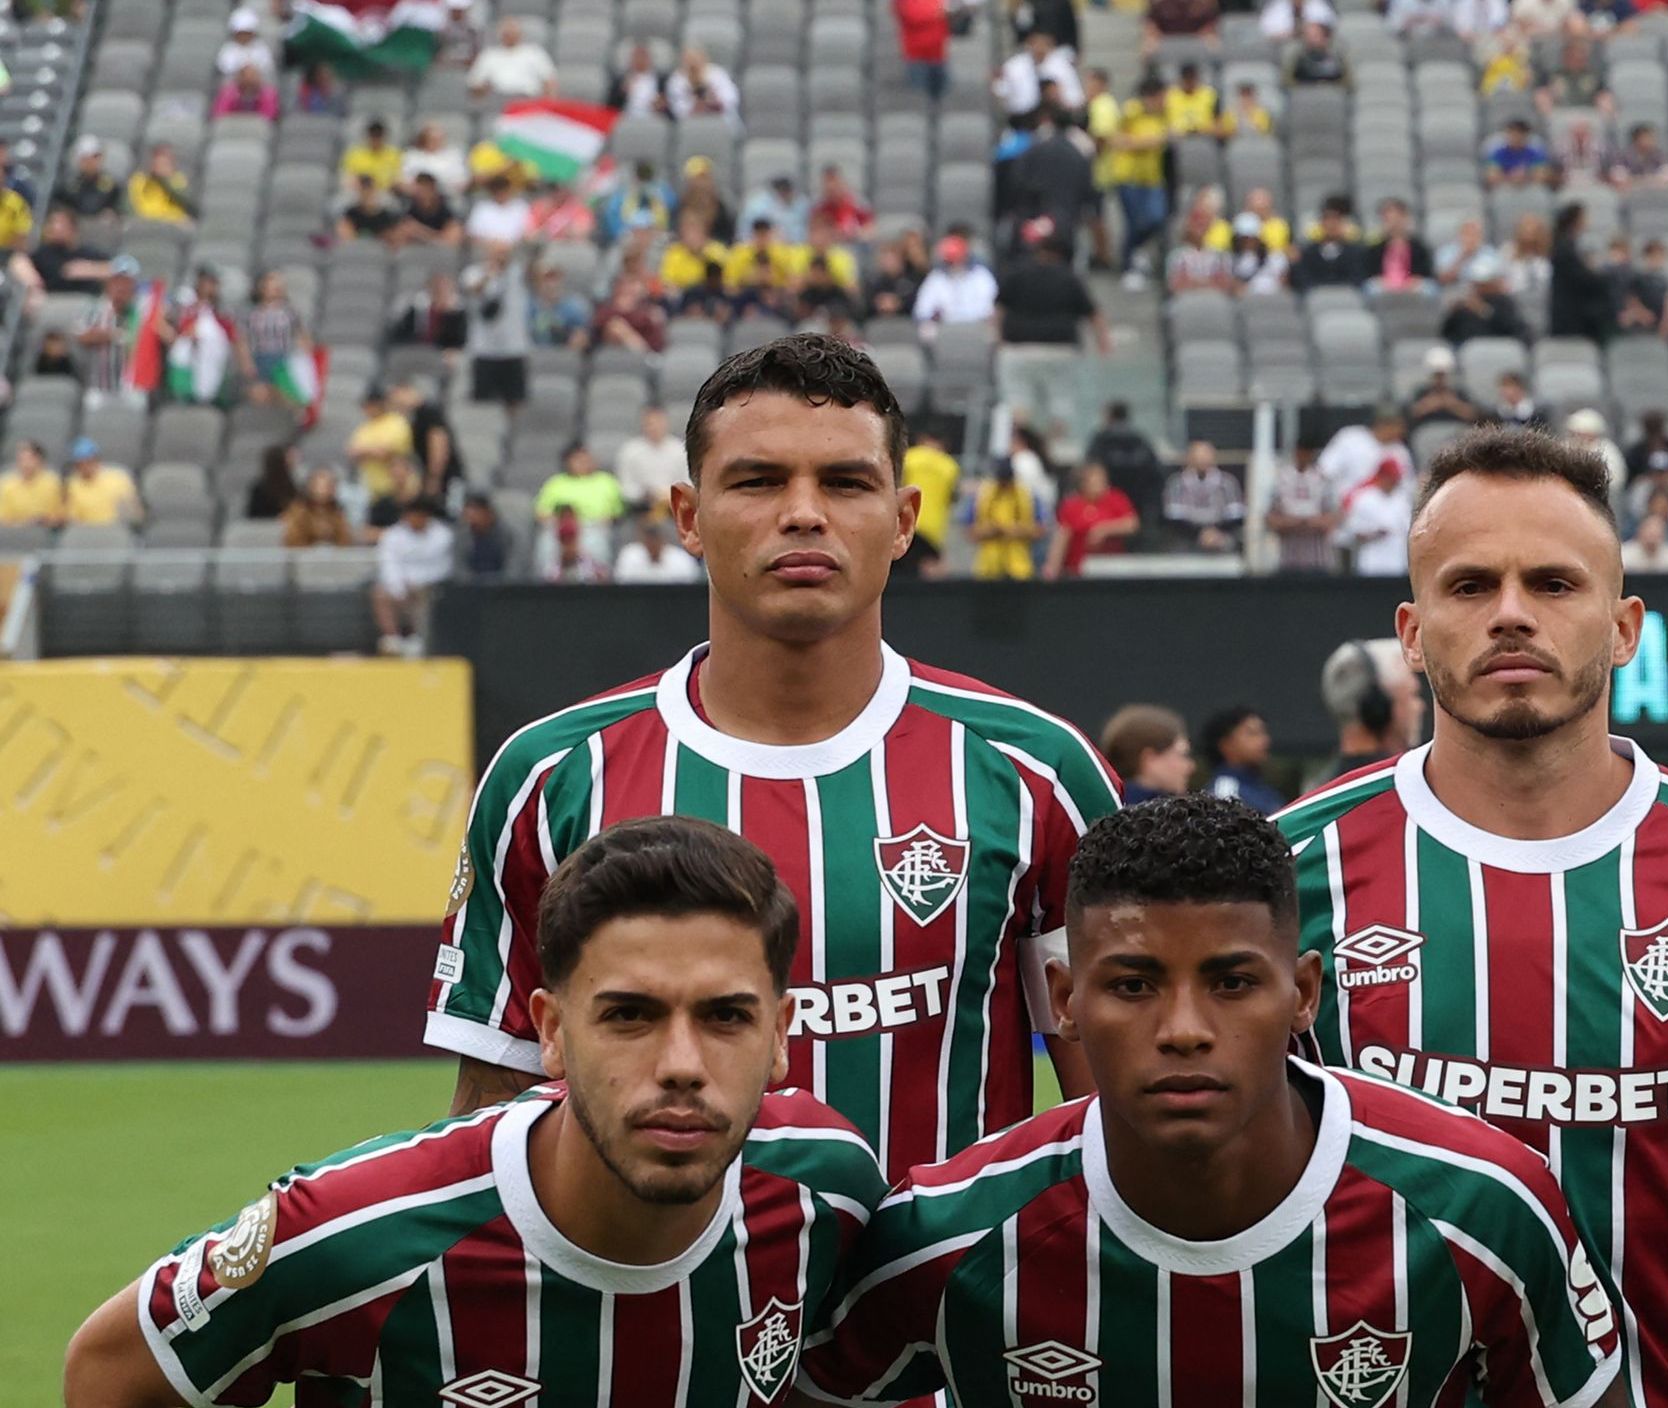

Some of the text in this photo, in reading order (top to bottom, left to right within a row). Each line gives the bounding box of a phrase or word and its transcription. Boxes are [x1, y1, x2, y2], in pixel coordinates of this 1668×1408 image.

[0, 928, 340, 1037] WAYS
[1340, 966, 1416, 988] umbro
[1013, 1380, 1093, 1402] umbro
